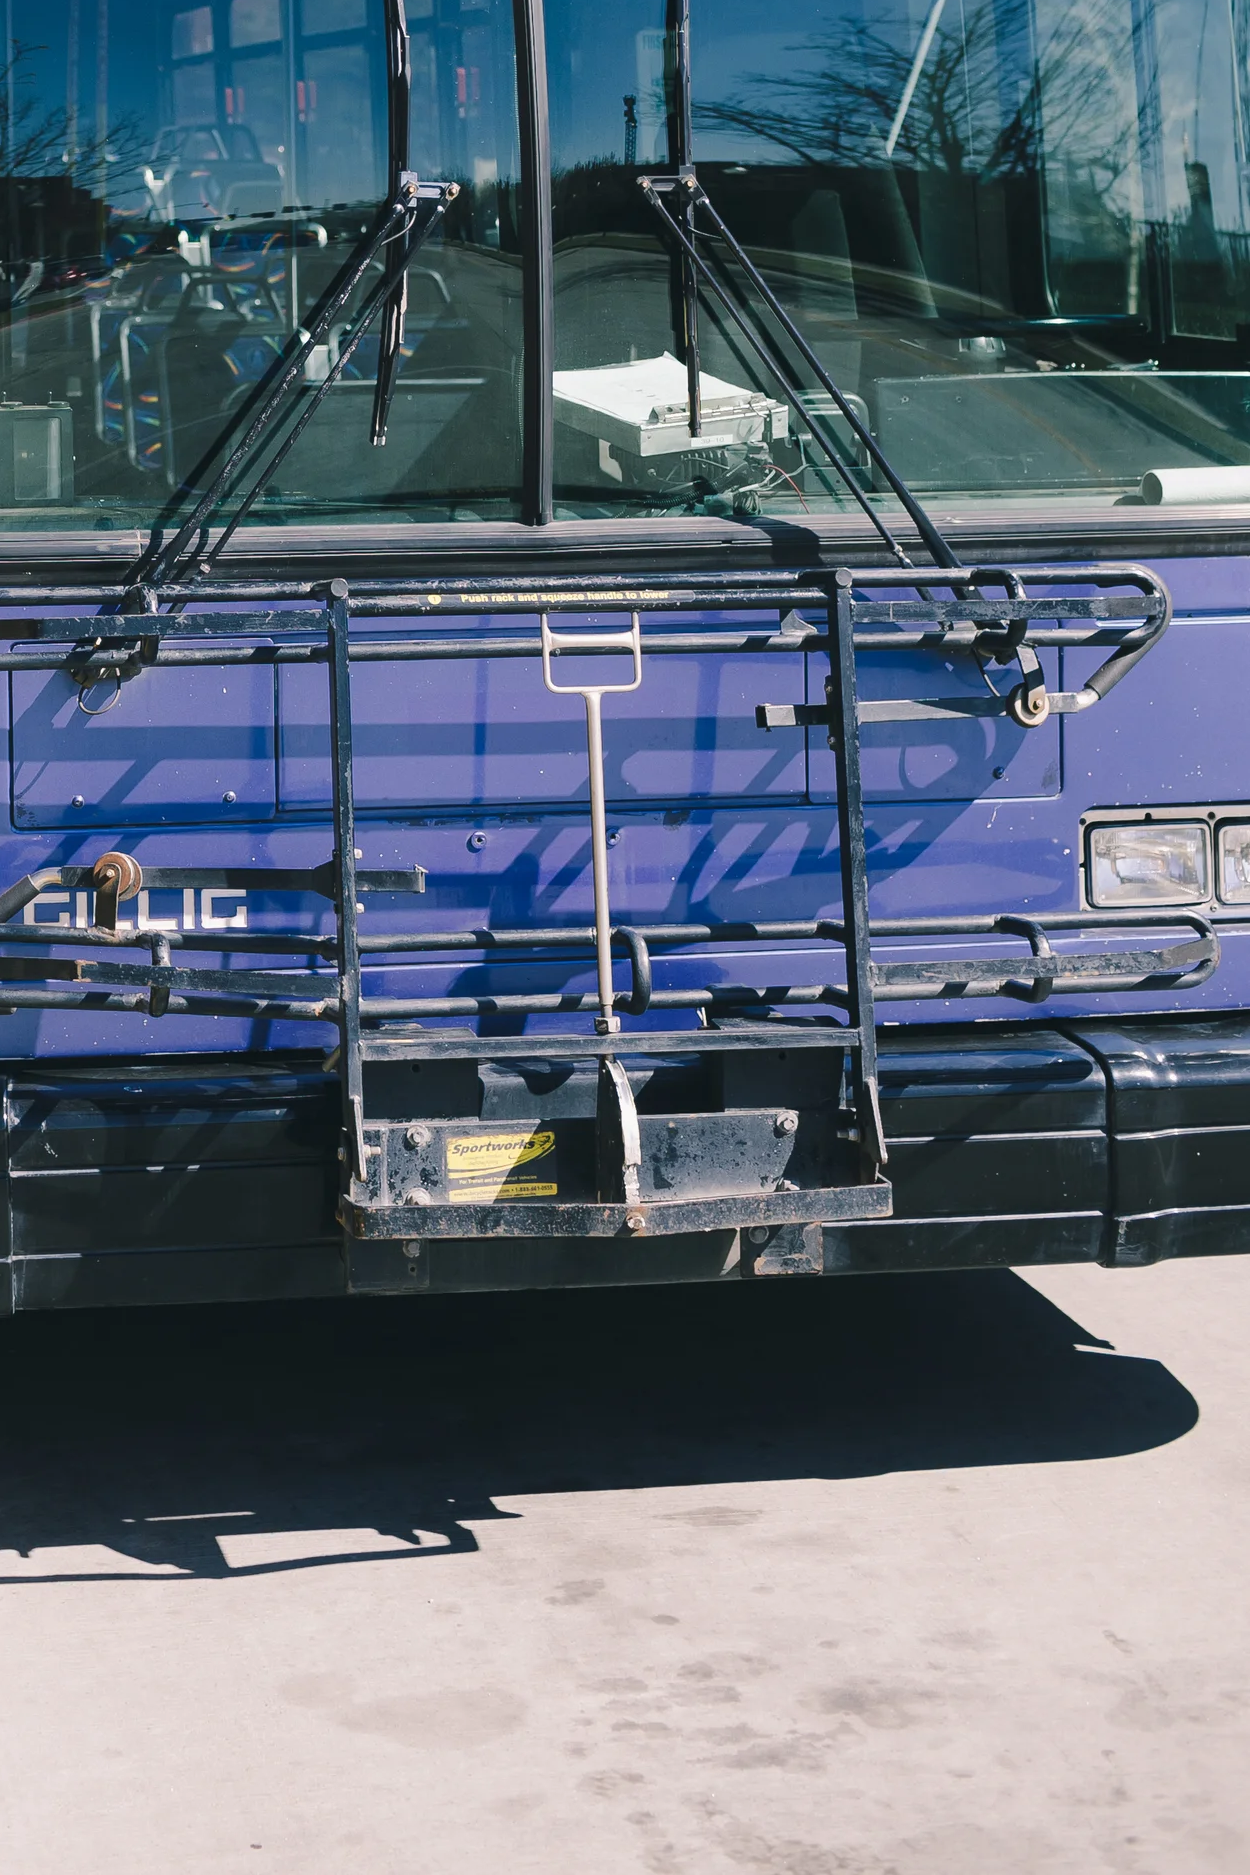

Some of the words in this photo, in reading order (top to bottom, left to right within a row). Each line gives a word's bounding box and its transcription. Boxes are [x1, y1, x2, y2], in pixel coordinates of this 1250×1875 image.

[461, 594, 488, 602] Push
[491, 594, 515, 602] rack
[518, 594, 538, 602] and
[540, 593, 585, 603] squeeze
[586, 591, 623, 600] handle
[640, 591, 669, 599] lower
[452, 1139, 536, 1156] Sportworks
